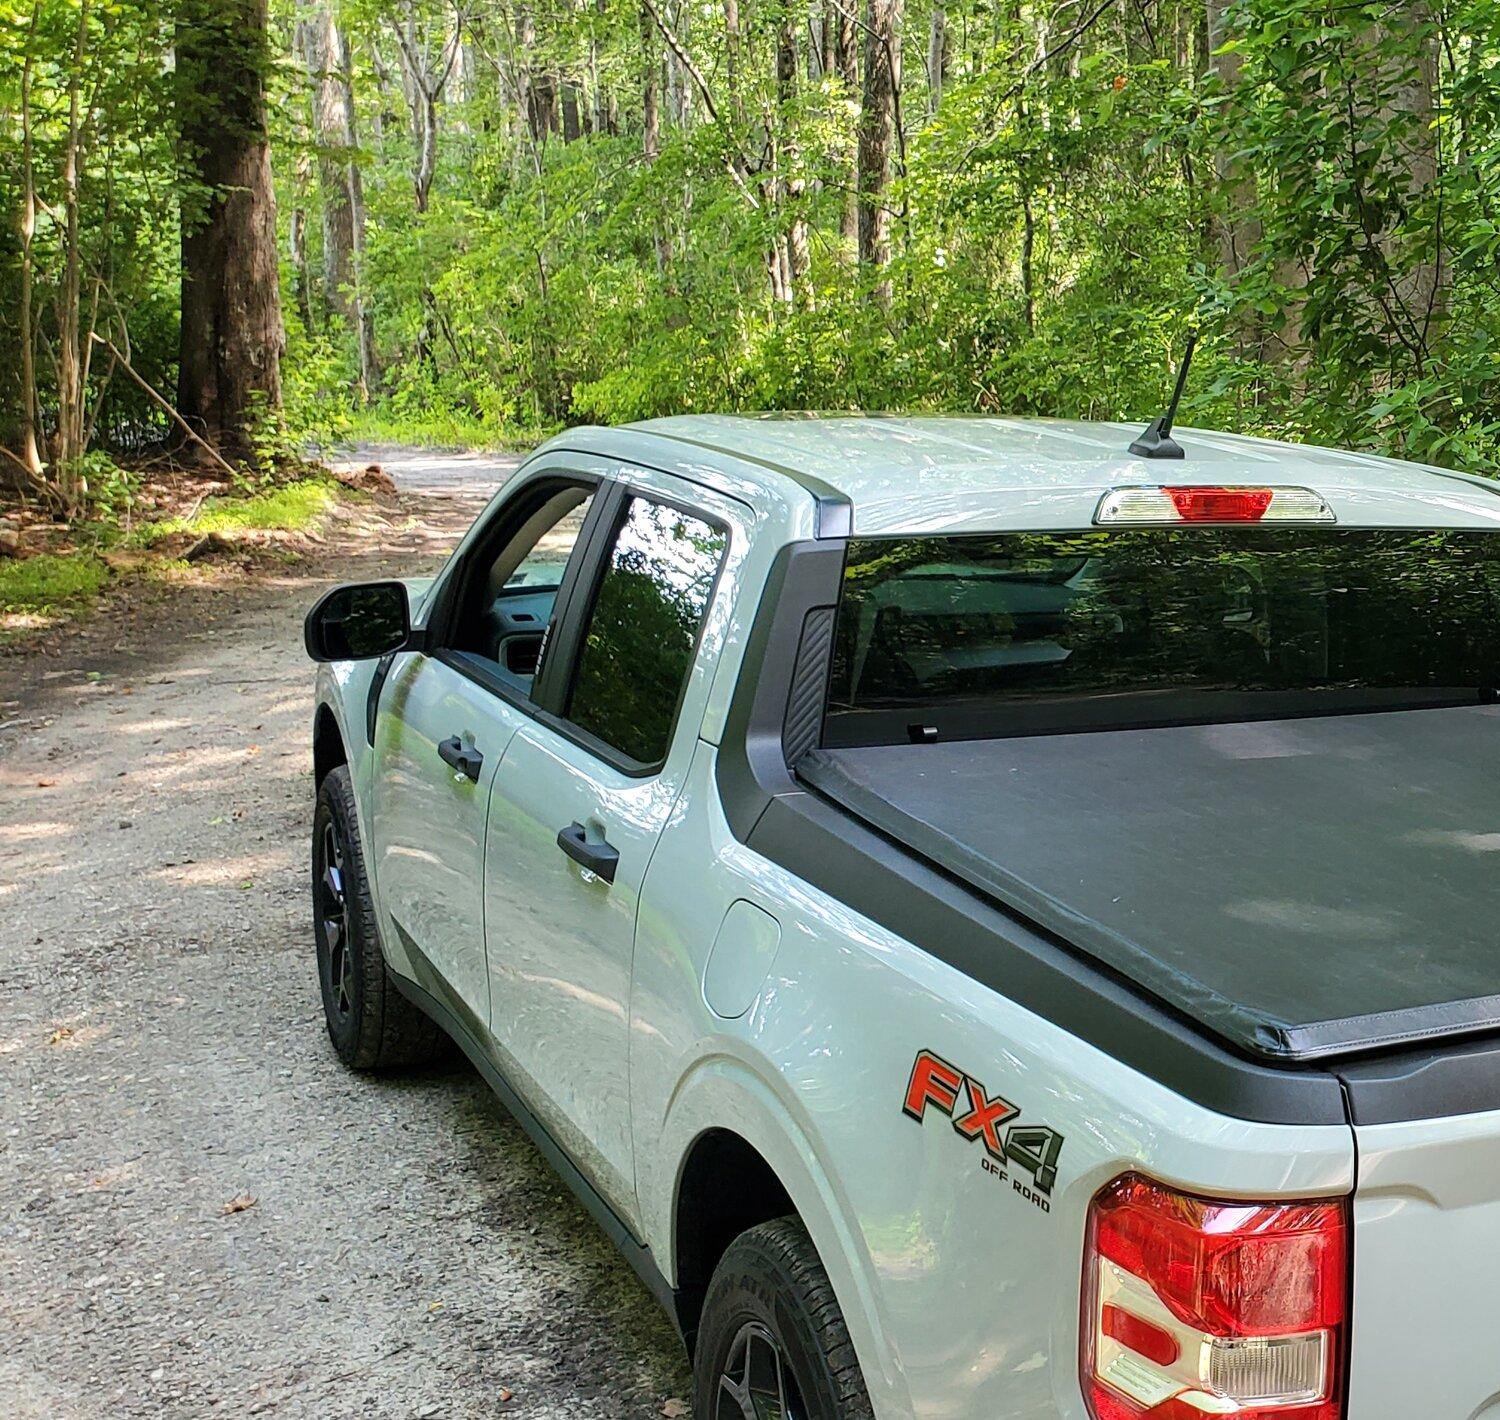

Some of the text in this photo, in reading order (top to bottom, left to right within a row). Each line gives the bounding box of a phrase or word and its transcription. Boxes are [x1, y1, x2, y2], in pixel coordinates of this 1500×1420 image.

[902, 1048, 1065, 1197] FX4
[981, 1158, 1050, 1213] OFF ROAD
